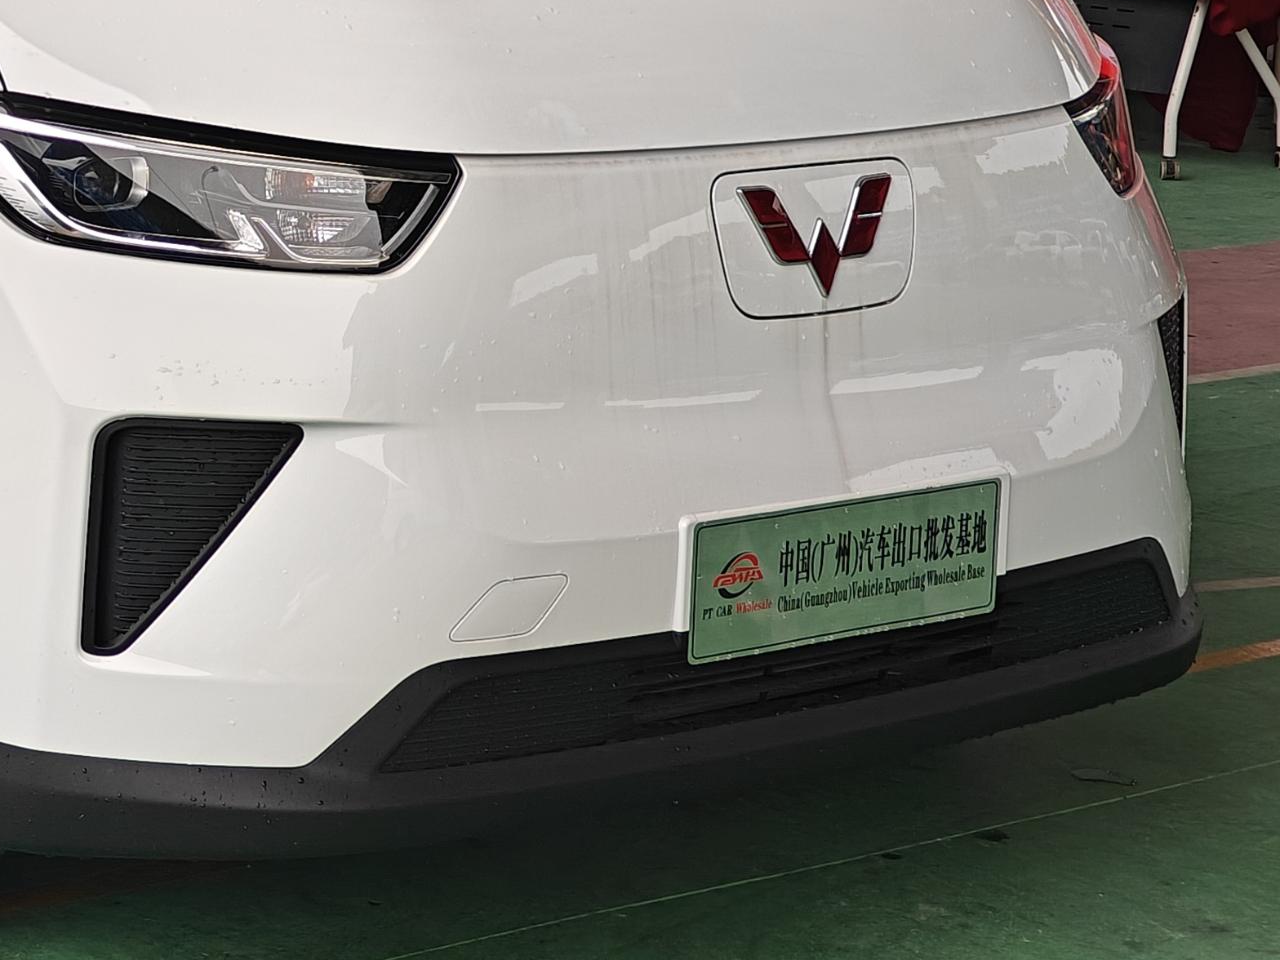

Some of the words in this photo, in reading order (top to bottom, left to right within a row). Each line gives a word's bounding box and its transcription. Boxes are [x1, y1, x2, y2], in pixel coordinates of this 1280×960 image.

[778, 509, 988, 588] 中国(广州)汽车出口批发基地
[884, 571, 927, 597] Exporting
[926, 566, 966, 587] Wholesale
[967, 563, 986, 581] Base
[716, 604, 733, 618] CAR
